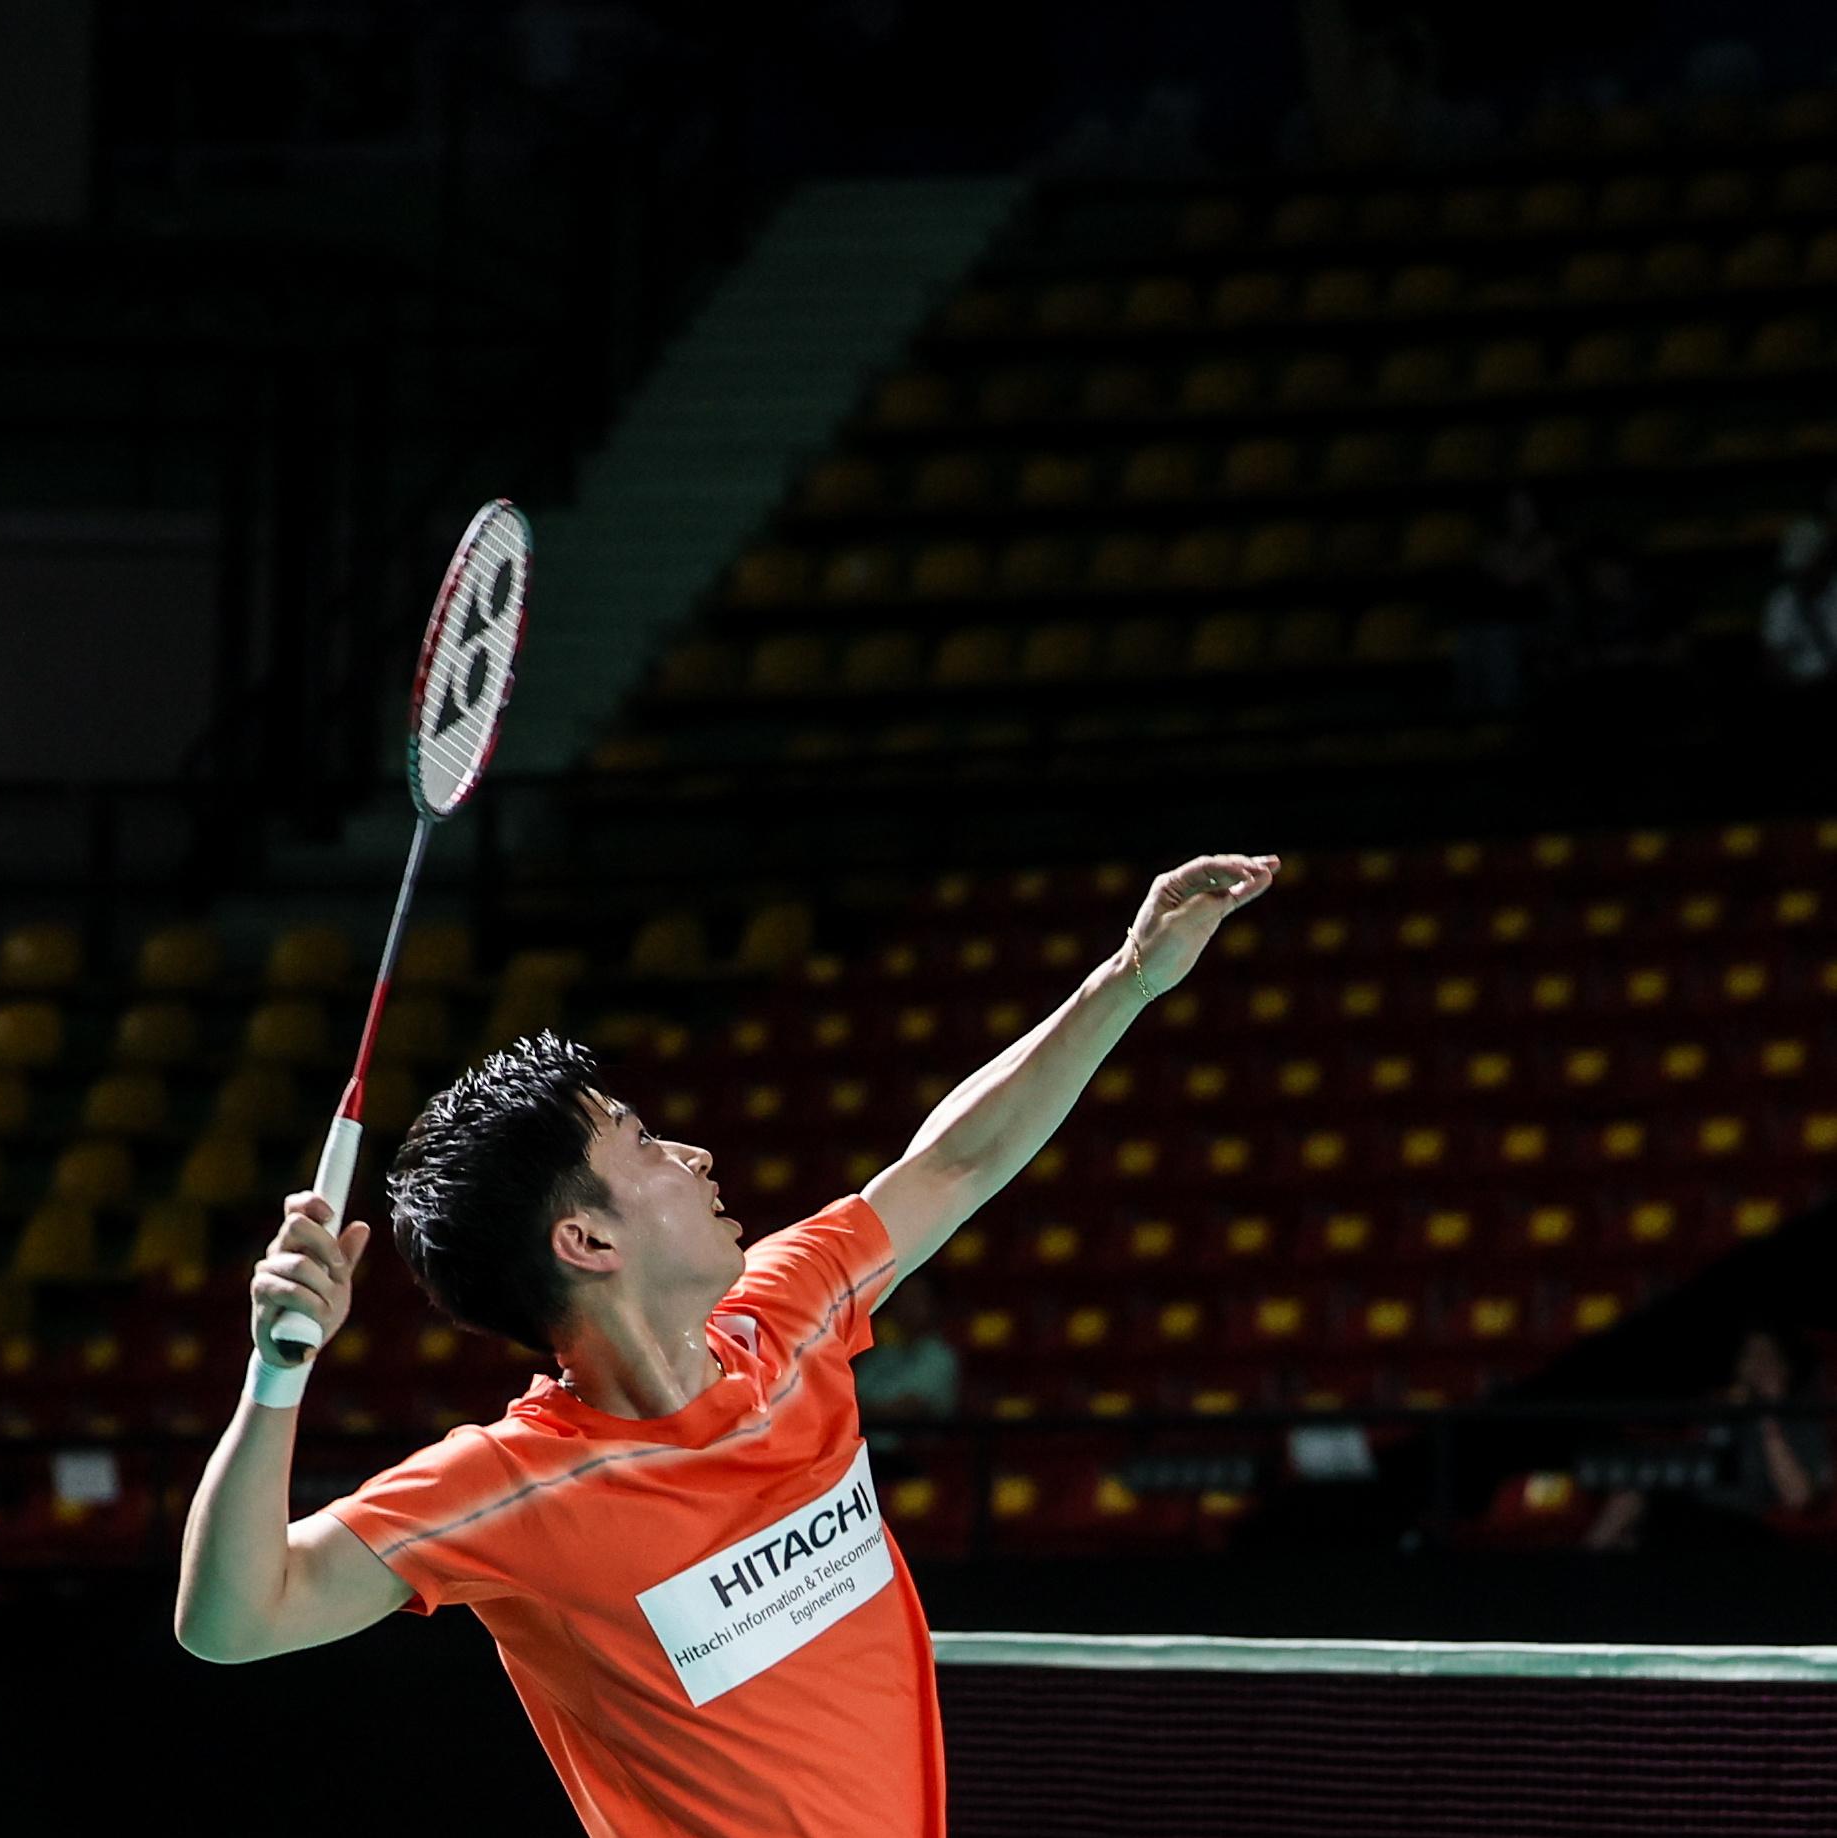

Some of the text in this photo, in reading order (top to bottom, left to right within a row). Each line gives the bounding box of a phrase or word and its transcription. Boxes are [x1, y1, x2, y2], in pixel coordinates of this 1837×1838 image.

[710, 1481, 872, 1608] HITACHI
[674, 1627, 734, 1667] Hitachi
[732, 1584, 805, 1636] Information
[804, 1574, 817, 1591] &
[789, 1575, 855, 1625] Engineering
